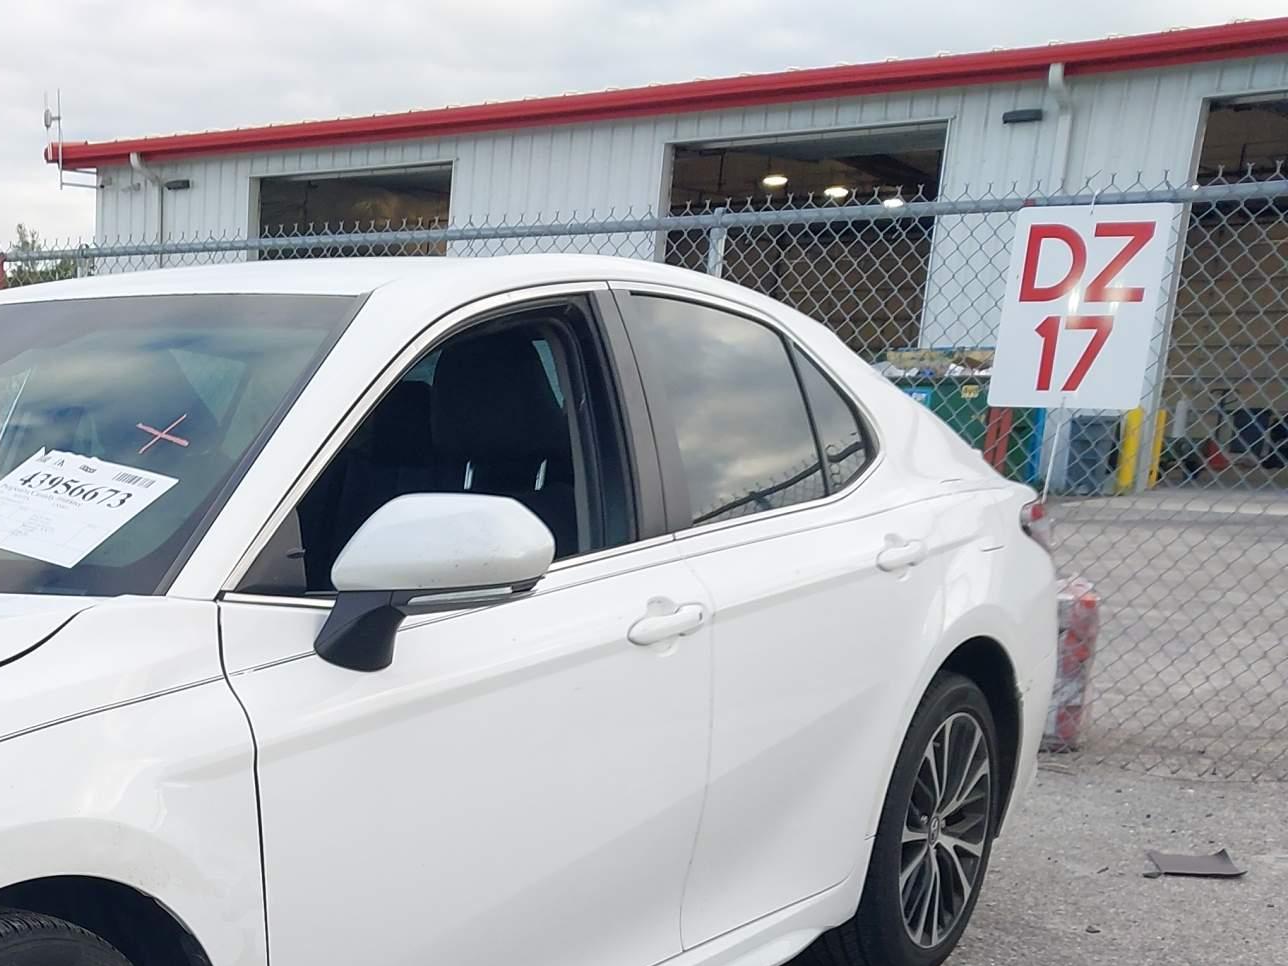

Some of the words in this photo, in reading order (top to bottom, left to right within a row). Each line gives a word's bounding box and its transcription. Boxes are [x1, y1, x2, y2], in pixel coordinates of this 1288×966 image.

[1019, 222, 1156, 302] DZ
[1034, 315, 1114, 391] 17
[19, 471, 133, 508] 43956673
